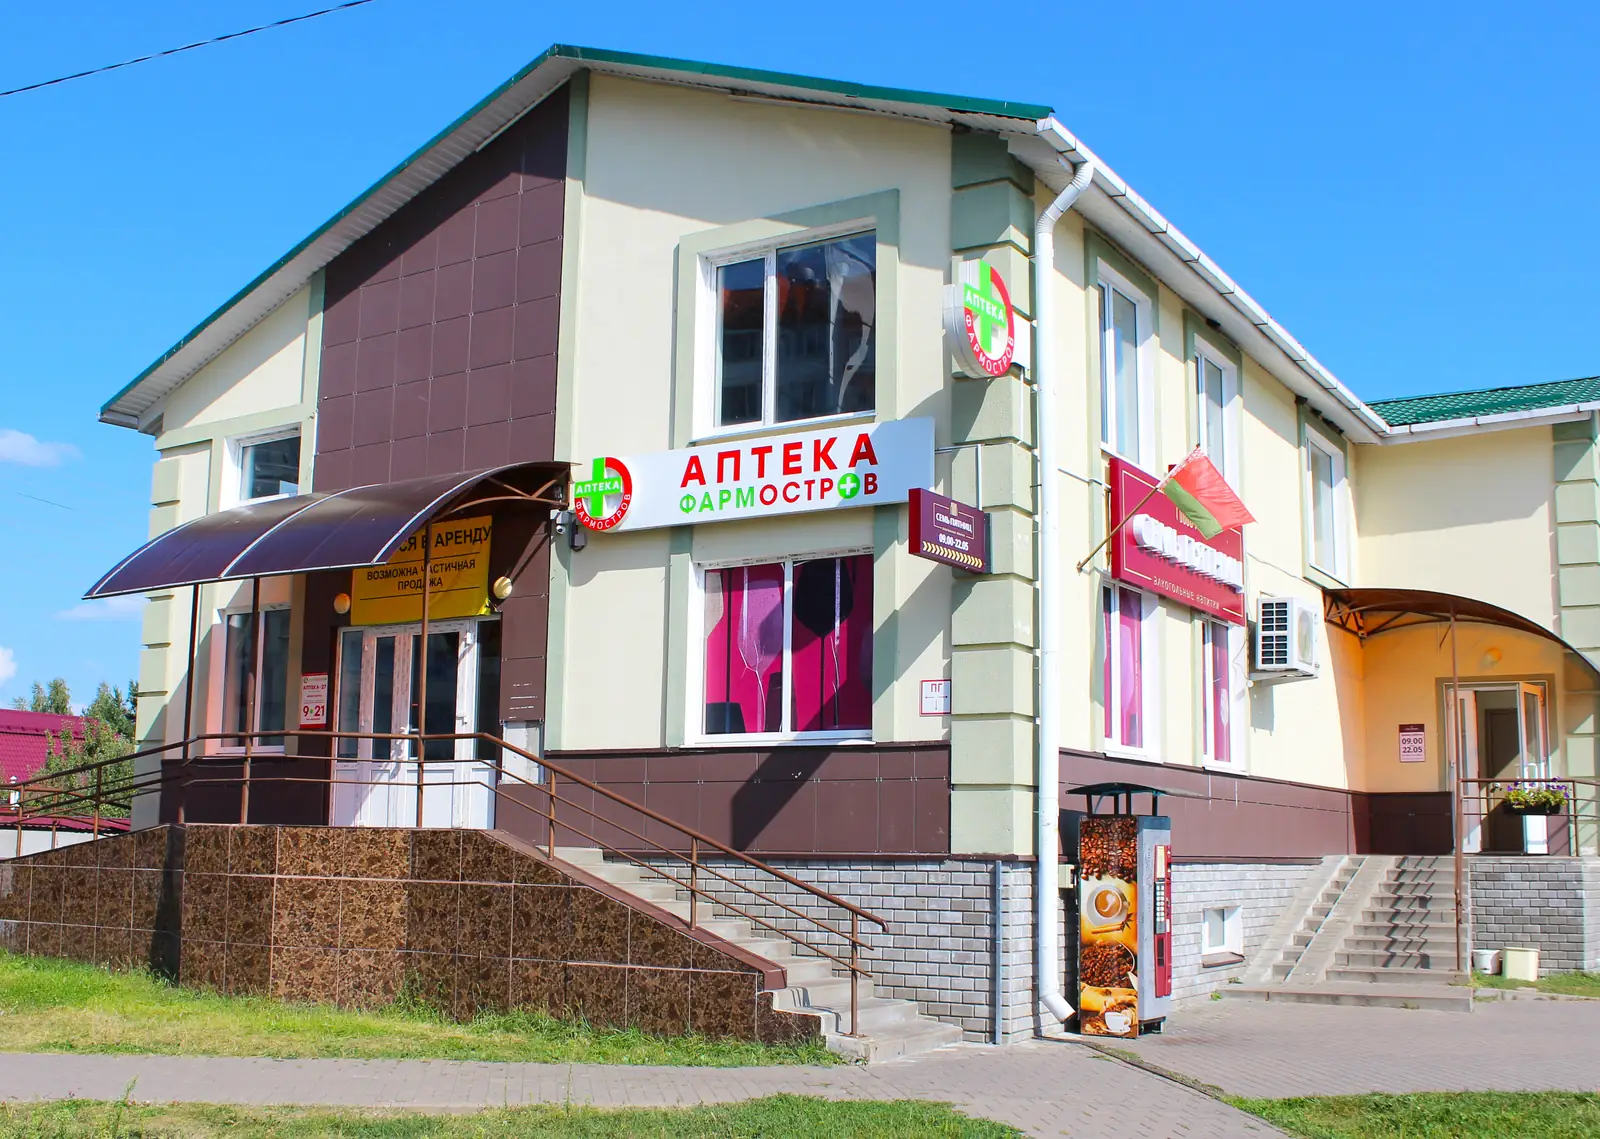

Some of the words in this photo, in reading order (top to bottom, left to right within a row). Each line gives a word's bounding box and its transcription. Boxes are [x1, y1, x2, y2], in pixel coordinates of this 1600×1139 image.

[965, 290, 1005, 323] АПТЕКА
[965, 314, 1014, 374] ФАРМОСТРОВ
[680, 432, 879, 488] АПТЕКА
[576, 480, 620, 494] АПТЕКА
[575, 493, 631, 530] ФАРМОСТРОВ
[434, 525, 492, 548] АРЕНДУ
[366, 566, 419, 581] ВОЗМОЖНА
[397, 577, 444, 591] ПРОДЖА
[314, 705, 325, 716] 21
[1402, 737, 1423, 745] 09.00
